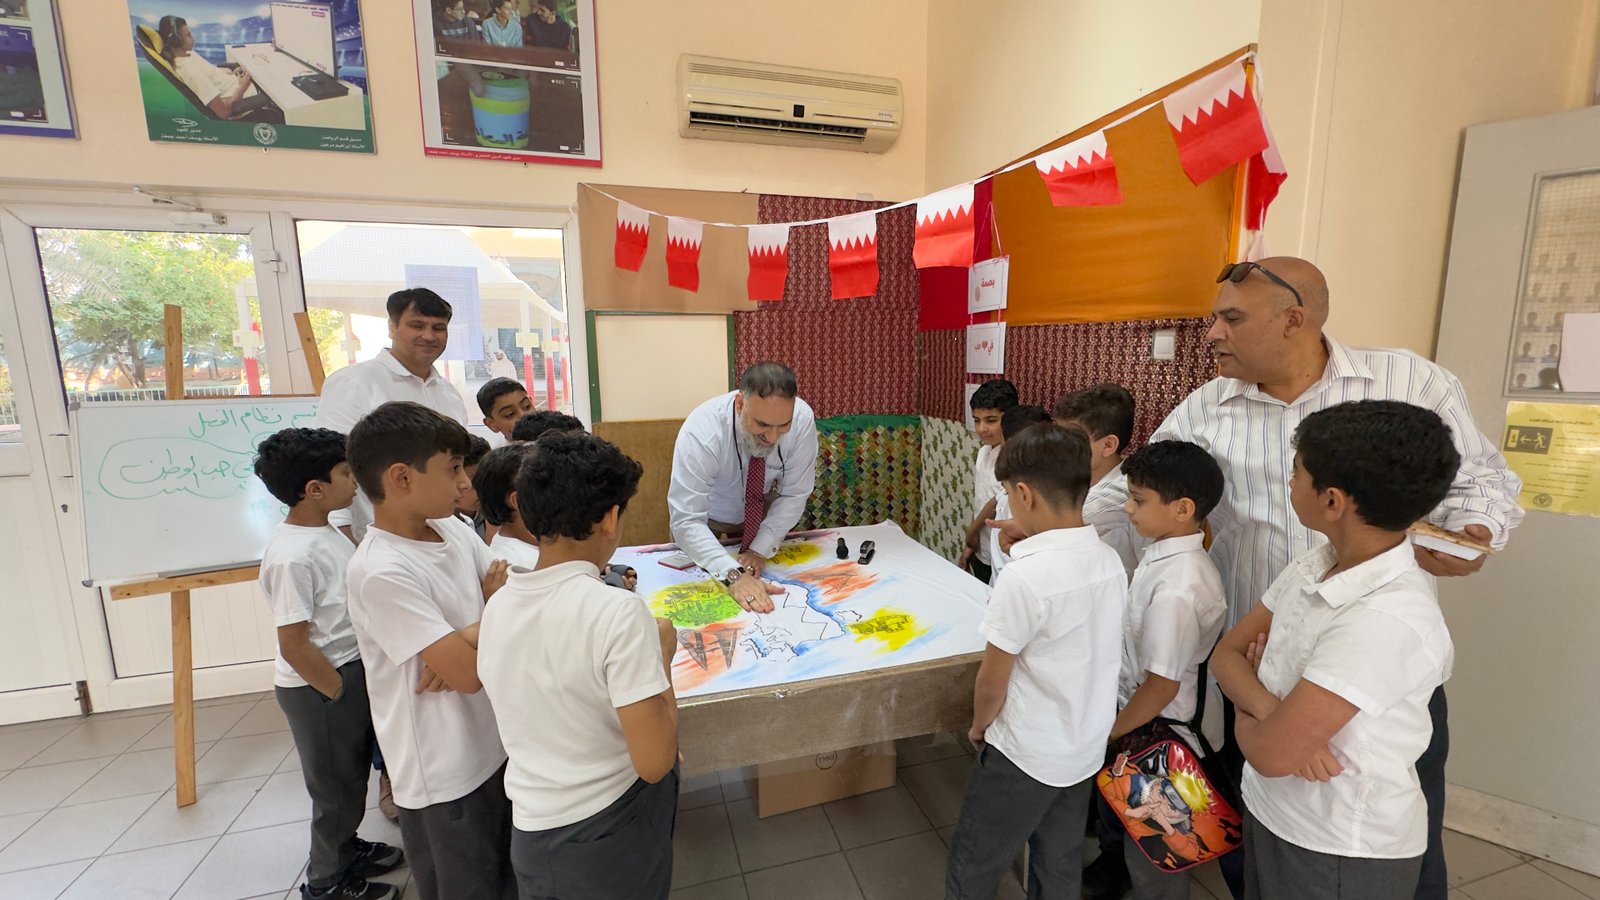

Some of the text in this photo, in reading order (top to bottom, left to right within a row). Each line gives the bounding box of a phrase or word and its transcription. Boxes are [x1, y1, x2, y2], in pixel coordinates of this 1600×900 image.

[981, 277, 995, 288] بصمة
[189, 409, 237, 439] الفصل
[240, 406, 282, 433] نظام
[201, 460, 231, 480] حب
